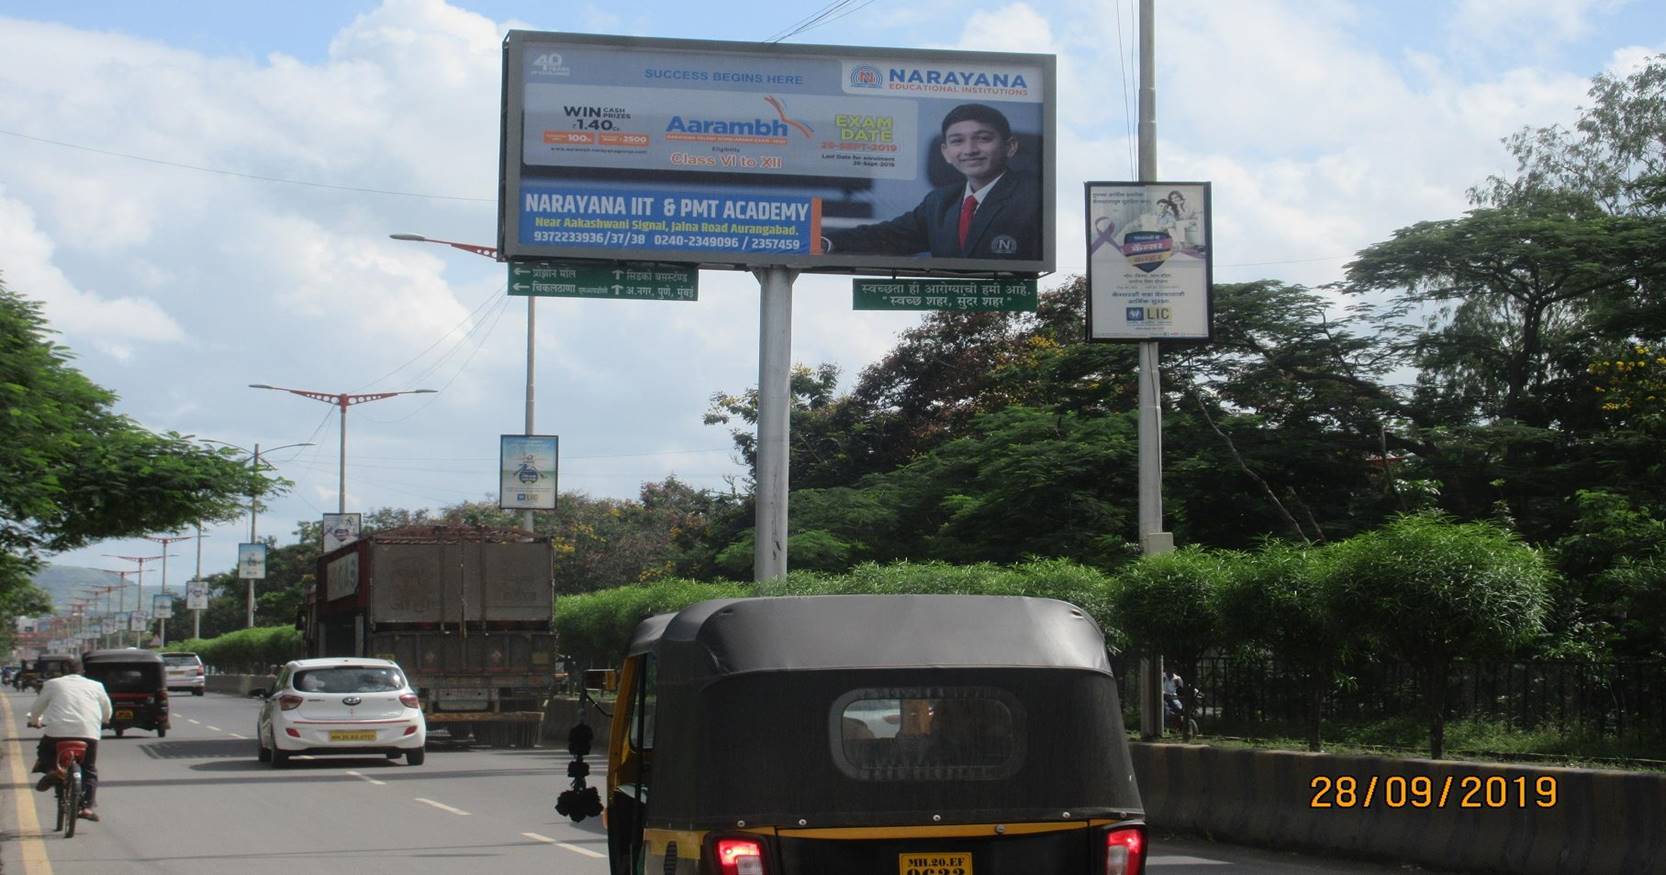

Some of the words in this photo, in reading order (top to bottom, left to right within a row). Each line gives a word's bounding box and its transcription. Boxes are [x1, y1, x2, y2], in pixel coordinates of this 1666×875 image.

[533, 53, 562, 71] 40
[644, 69, 709, 80] SUCCESS
[713, 72, 763, 84] BEGINS
[767, 75, 804, 85] HERE
[889, 69, 1028, 88] NARAYANA
[889, 83, 960, 92] EDUCATIONAL
[961, 86, 1028, 96] INSTITUTIONS
[563, 105, 601, 118] WIN
[665, 115, 788, 136] Aarambh
[835, 114, 894, 128] EXAM
[841, 127, 894, 143] DATE
[671, 152, 716, 167] Class
[720, 154, 737, 168] VI
[741, 156, 758, 168] to
[760, 156, 784, 169] XII
[525, 193, 626, 214] NARAYANA
[631, 197, 654, 215] IIT
[664, 198, 676, 216] &
[680, 199, 719, 219] PMT
[723, 201, 809, 221] ACADEMY
[535, 217, 562, 228] Near
[563, 218, 629, 230] Aakashwani
[631, 220, 669, 232] Signal,
[671, 221, 698, 233] Jalna
[702, 223, 729, 233] Road
[731, 224, 799, 236] Aurangabad.
[533, 231, 646, 246] 9372233936/37/38
[654, 234, 739, 248] 0240-2349096
[752, 238, 800, 250] 2357459
[862, 284, 904, 296] स्वच्छता
[907, 281, 920, 295] ही
[925, 281, 977, 294] आरोग्याची
[981, 282, 1001, 295] हमी
[1006, 282, 1031, 297] आहे.
[957, 293, 978, 310] सुंदर
[1147, 307, 1170, 320] LIC
